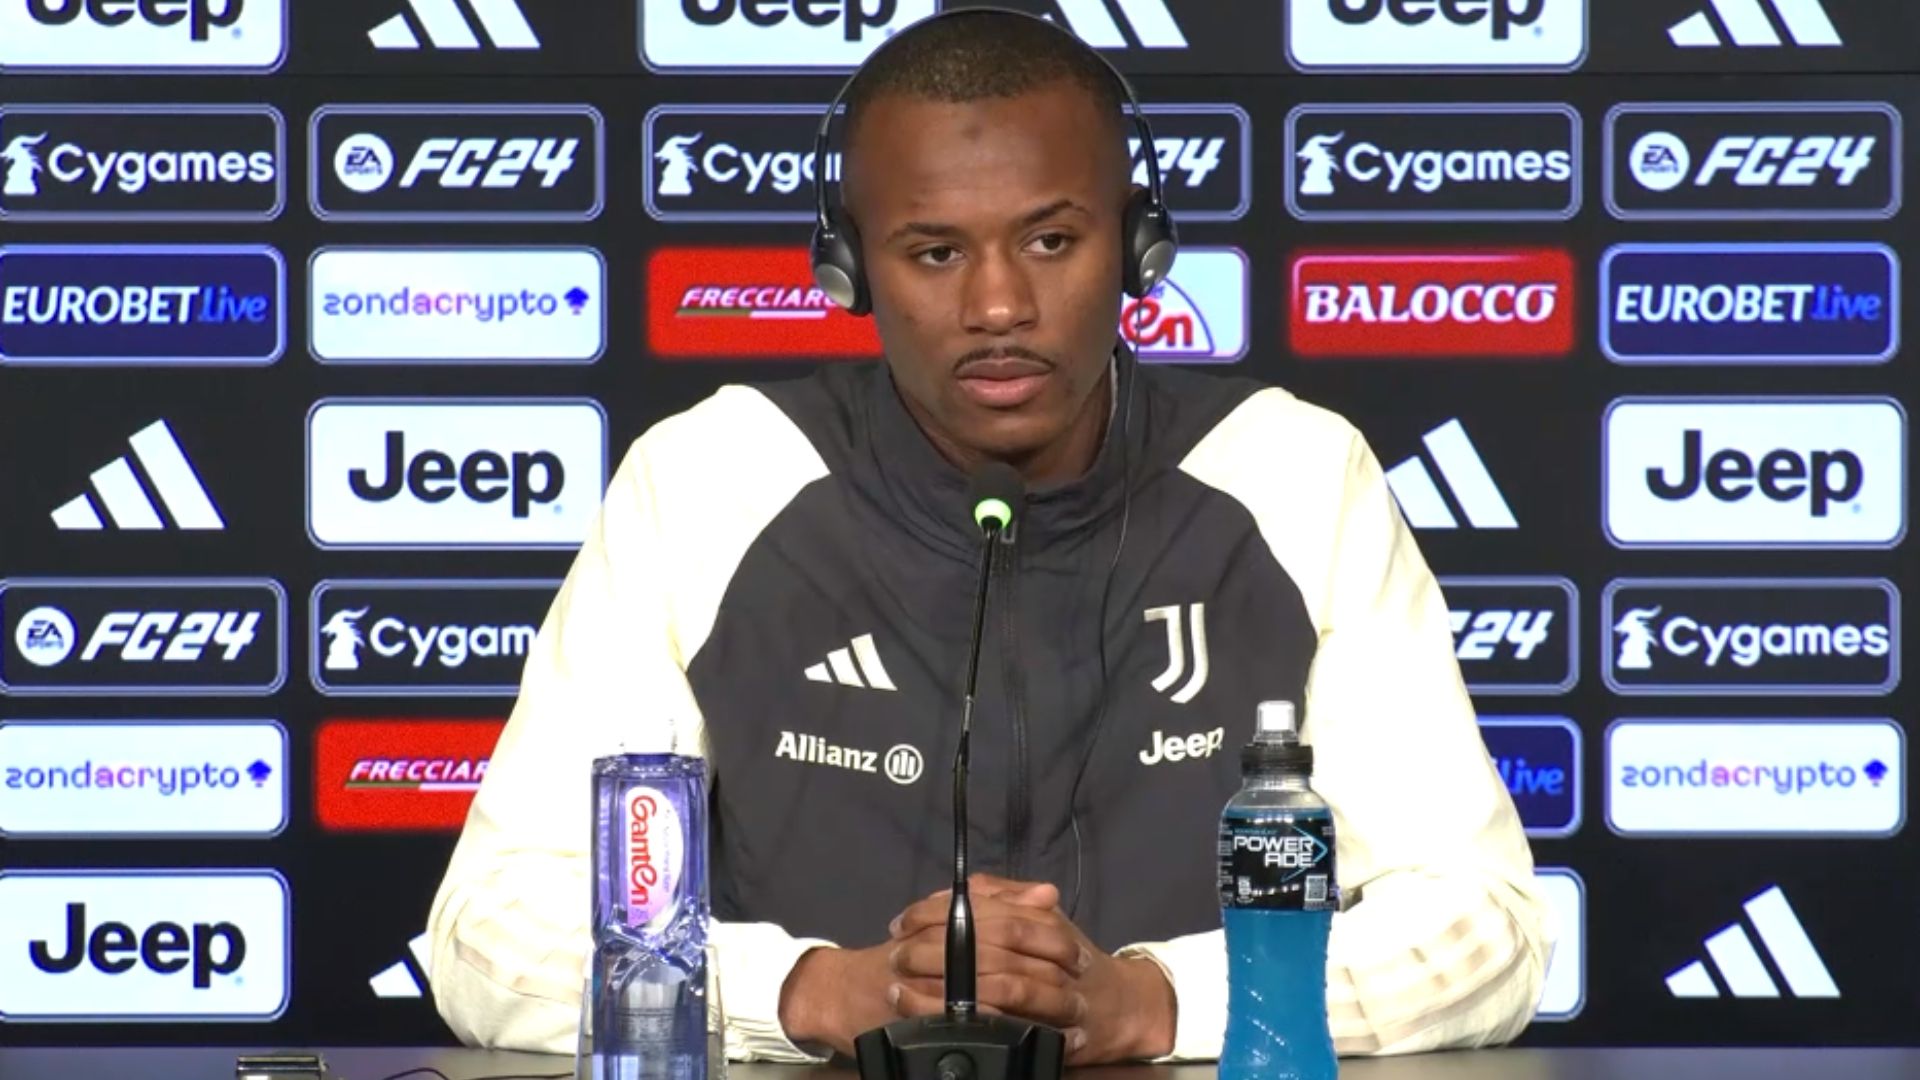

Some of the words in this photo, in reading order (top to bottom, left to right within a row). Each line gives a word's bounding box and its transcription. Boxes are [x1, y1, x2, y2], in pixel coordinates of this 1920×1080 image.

[48, 143, 275, 193] Cygames
[1345, 142, 1572, 193] Cygames
[1304, 283, 1558, 323] BALOCCO
[348, 430, 565, 518] Jeep
[1646, 429, 1863, 517] Jeep
[370, 617, 536, 667] Cygam
[1662, 616, 1890, 666] Cygames
[350, 760, 490, 780] FRECCIAR
[775, 731, 878, 773] Allianz
[1139, 727, 1225, 765] Jeep
[1234, 836, 1314, 852] POWER
[1264, 852, 1315, 868] ADE
[29, 902, 246, 989] Jeep
